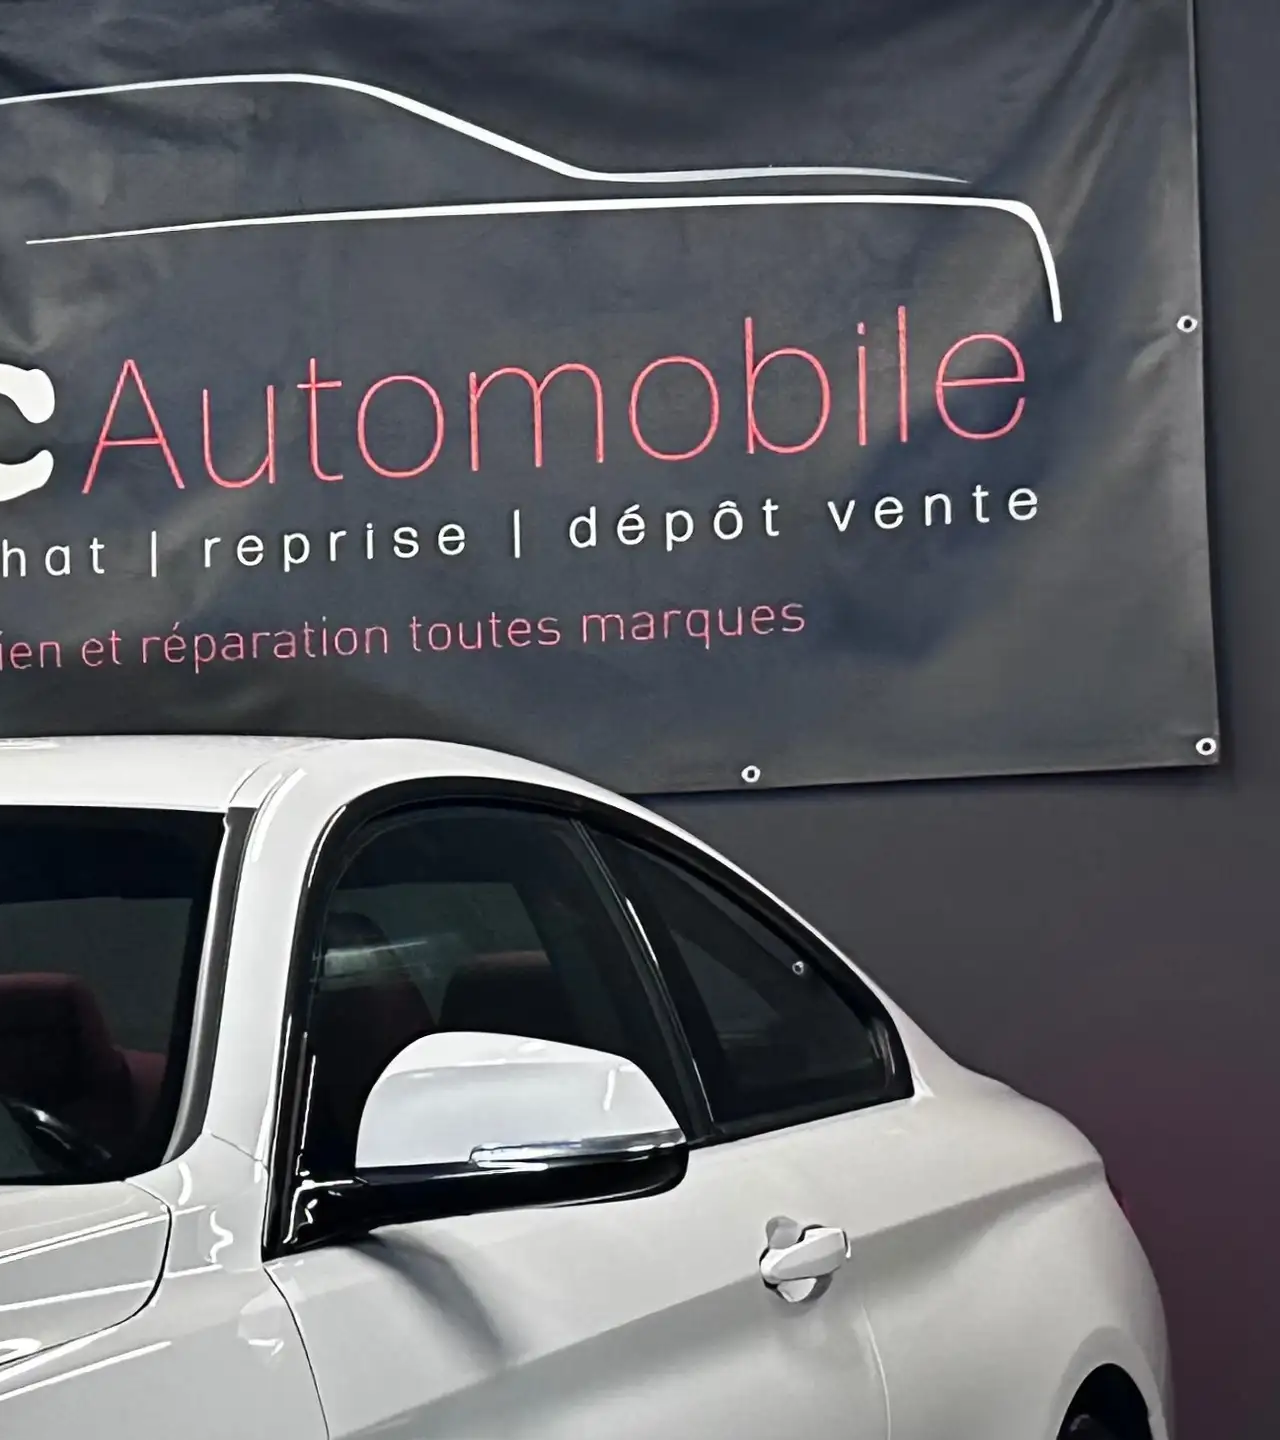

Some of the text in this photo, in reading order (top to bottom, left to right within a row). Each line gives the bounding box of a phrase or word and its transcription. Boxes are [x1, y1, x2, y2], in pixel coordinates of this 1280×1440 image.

[80, 305, 1026, 494] Automobile
[203, 523, 467, 573] reprise
[569, 497, 780, 551] dépôt
[827, 486, 1040, 534] vente
[81, 630, 122, 666] et
[141, 616, 389, 674] réparation
[410, 612, 561, 652] toutes
[582, 601, 806, 650] marques
